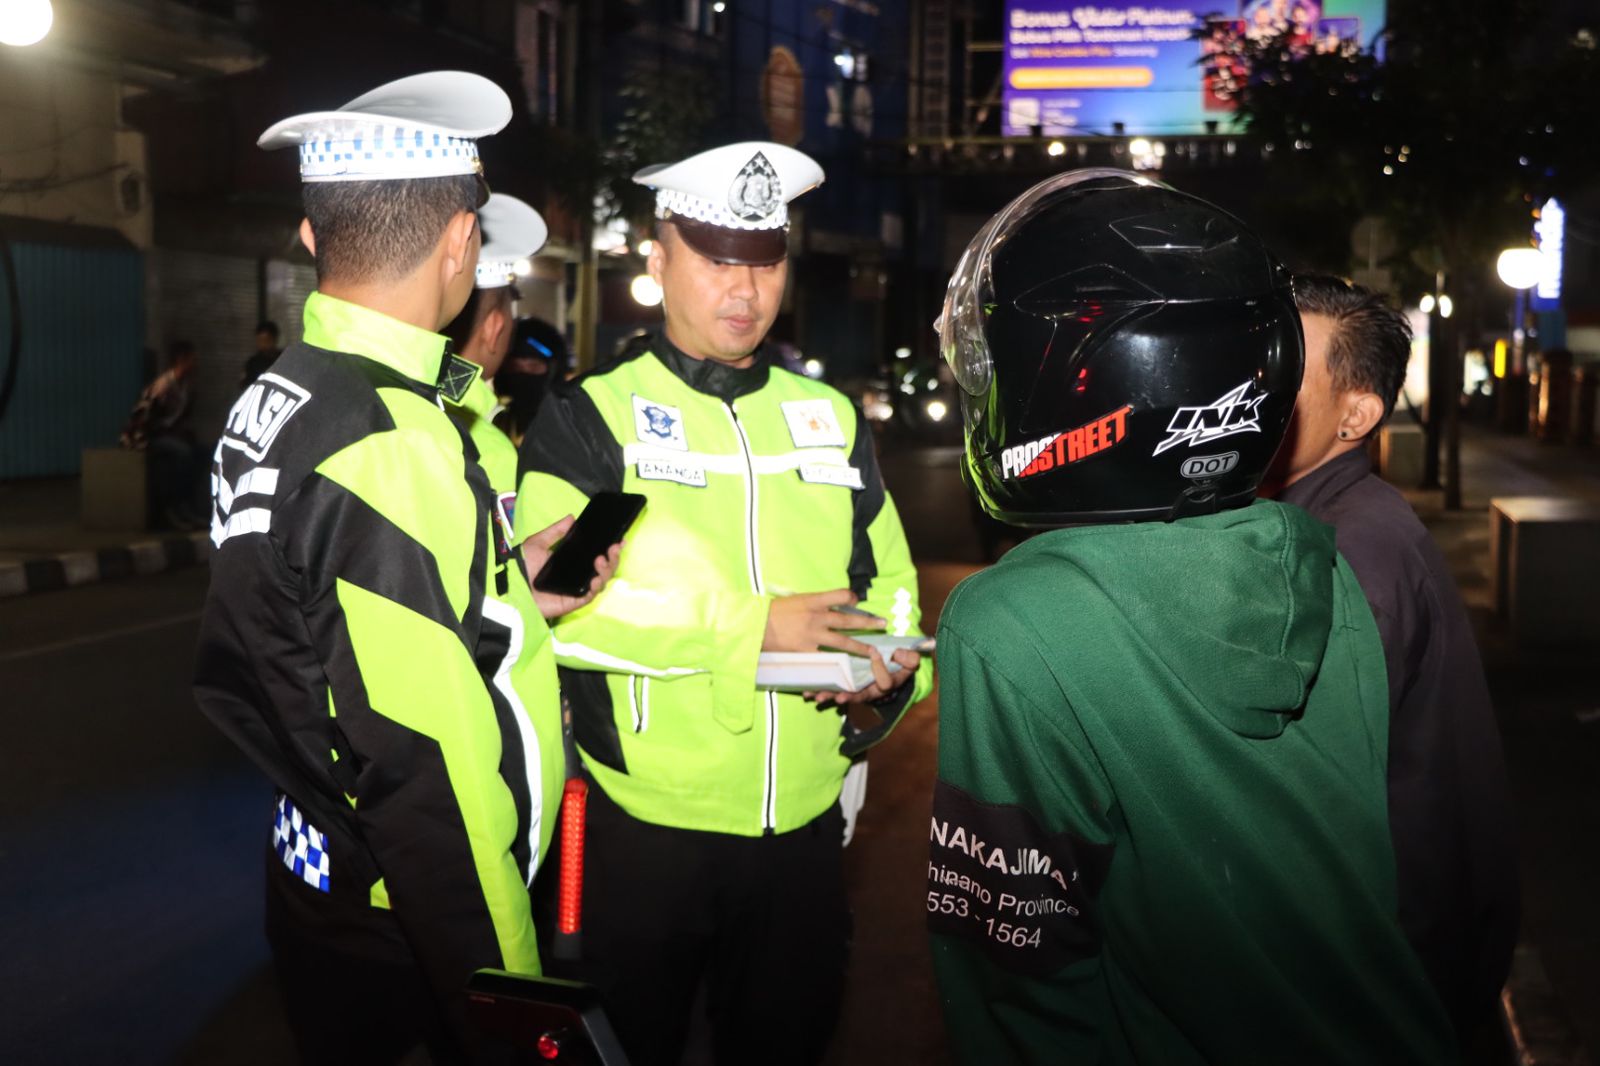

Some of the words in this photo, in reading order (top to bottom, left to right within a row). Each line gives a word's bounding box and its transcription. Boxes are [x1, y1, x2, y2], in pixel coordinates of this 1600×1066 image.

[1001, 404, 1132, 479] PROSTREET
[1187, 455, 1235, 476] DOT
[997, 893, 1080, 917] Province
[985, 917, 1042, 949] 1564
